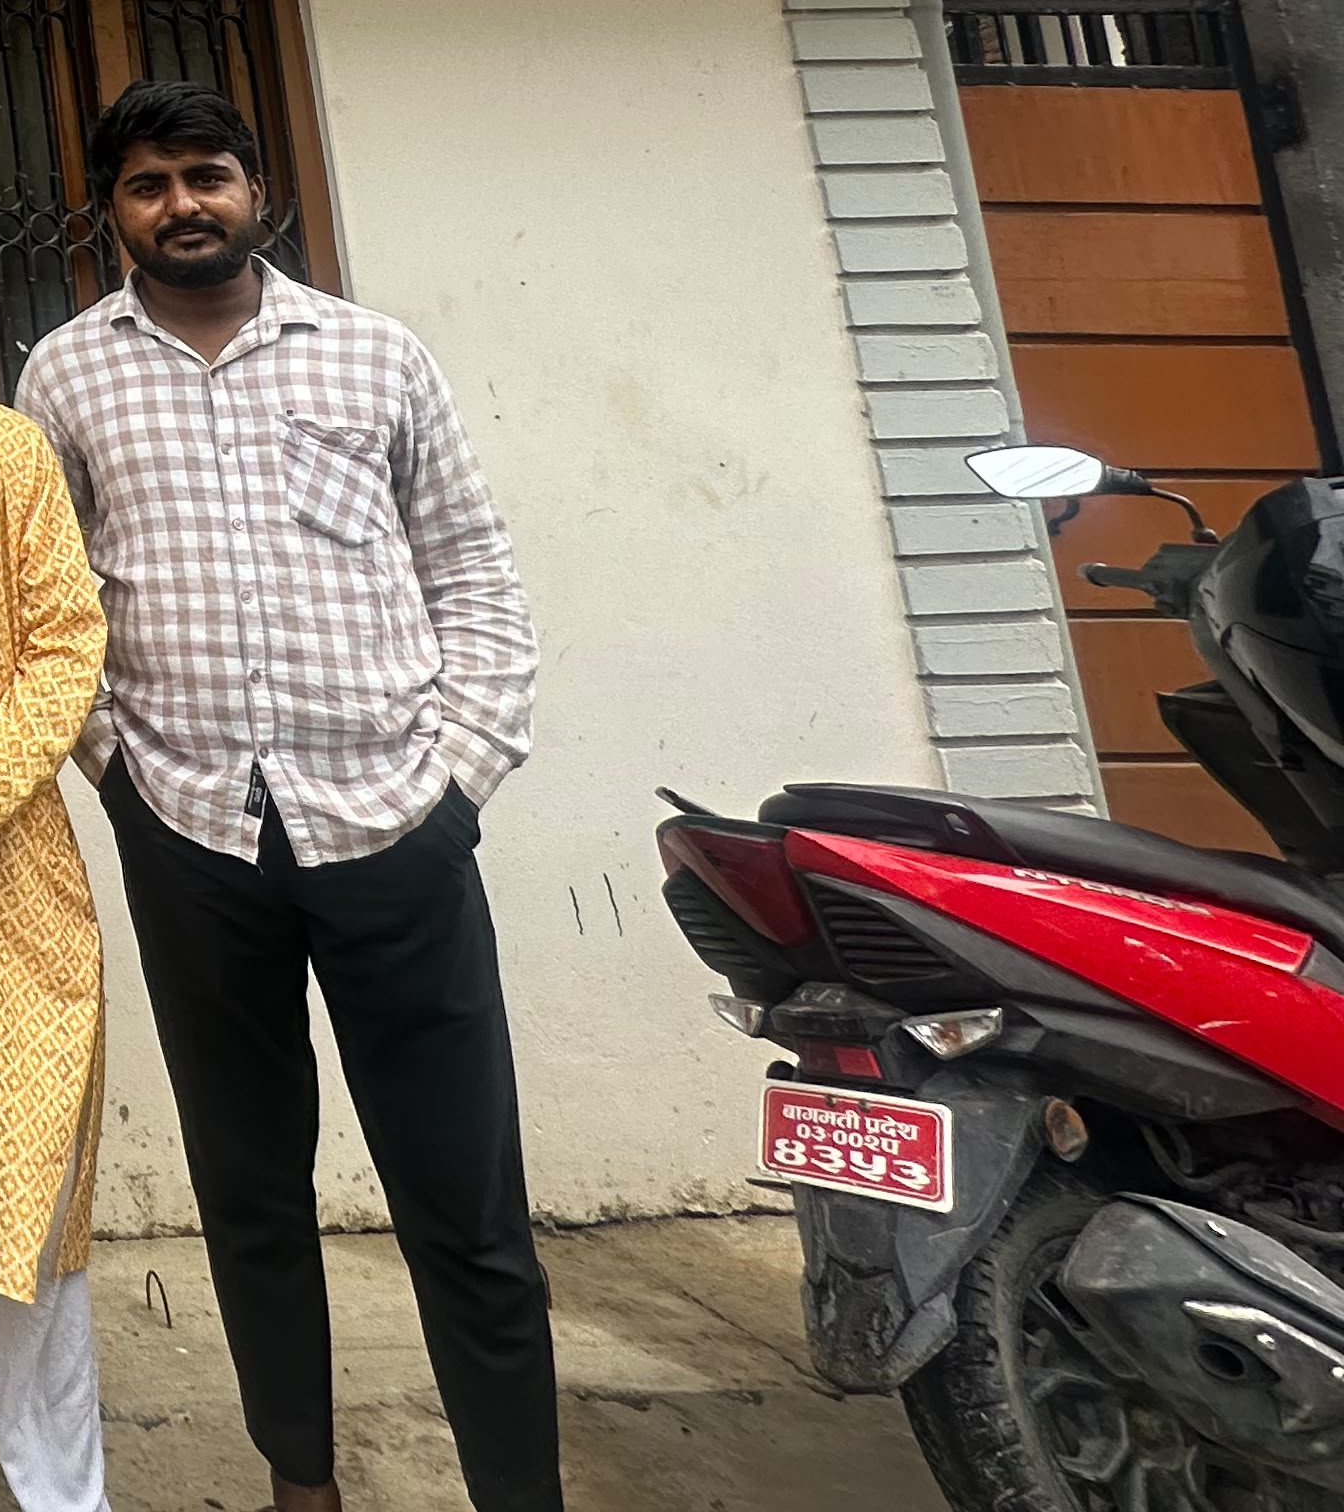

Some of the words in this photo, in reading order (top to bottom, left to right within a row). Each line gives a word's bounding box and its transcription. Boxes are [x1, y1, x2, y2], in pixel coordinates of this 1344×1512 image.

[782, 1103, 862, 1130] बागमती
[864, 1115, 921, 1142] प्रदेश
[773, 1138, 932, 1191] ४३५३
